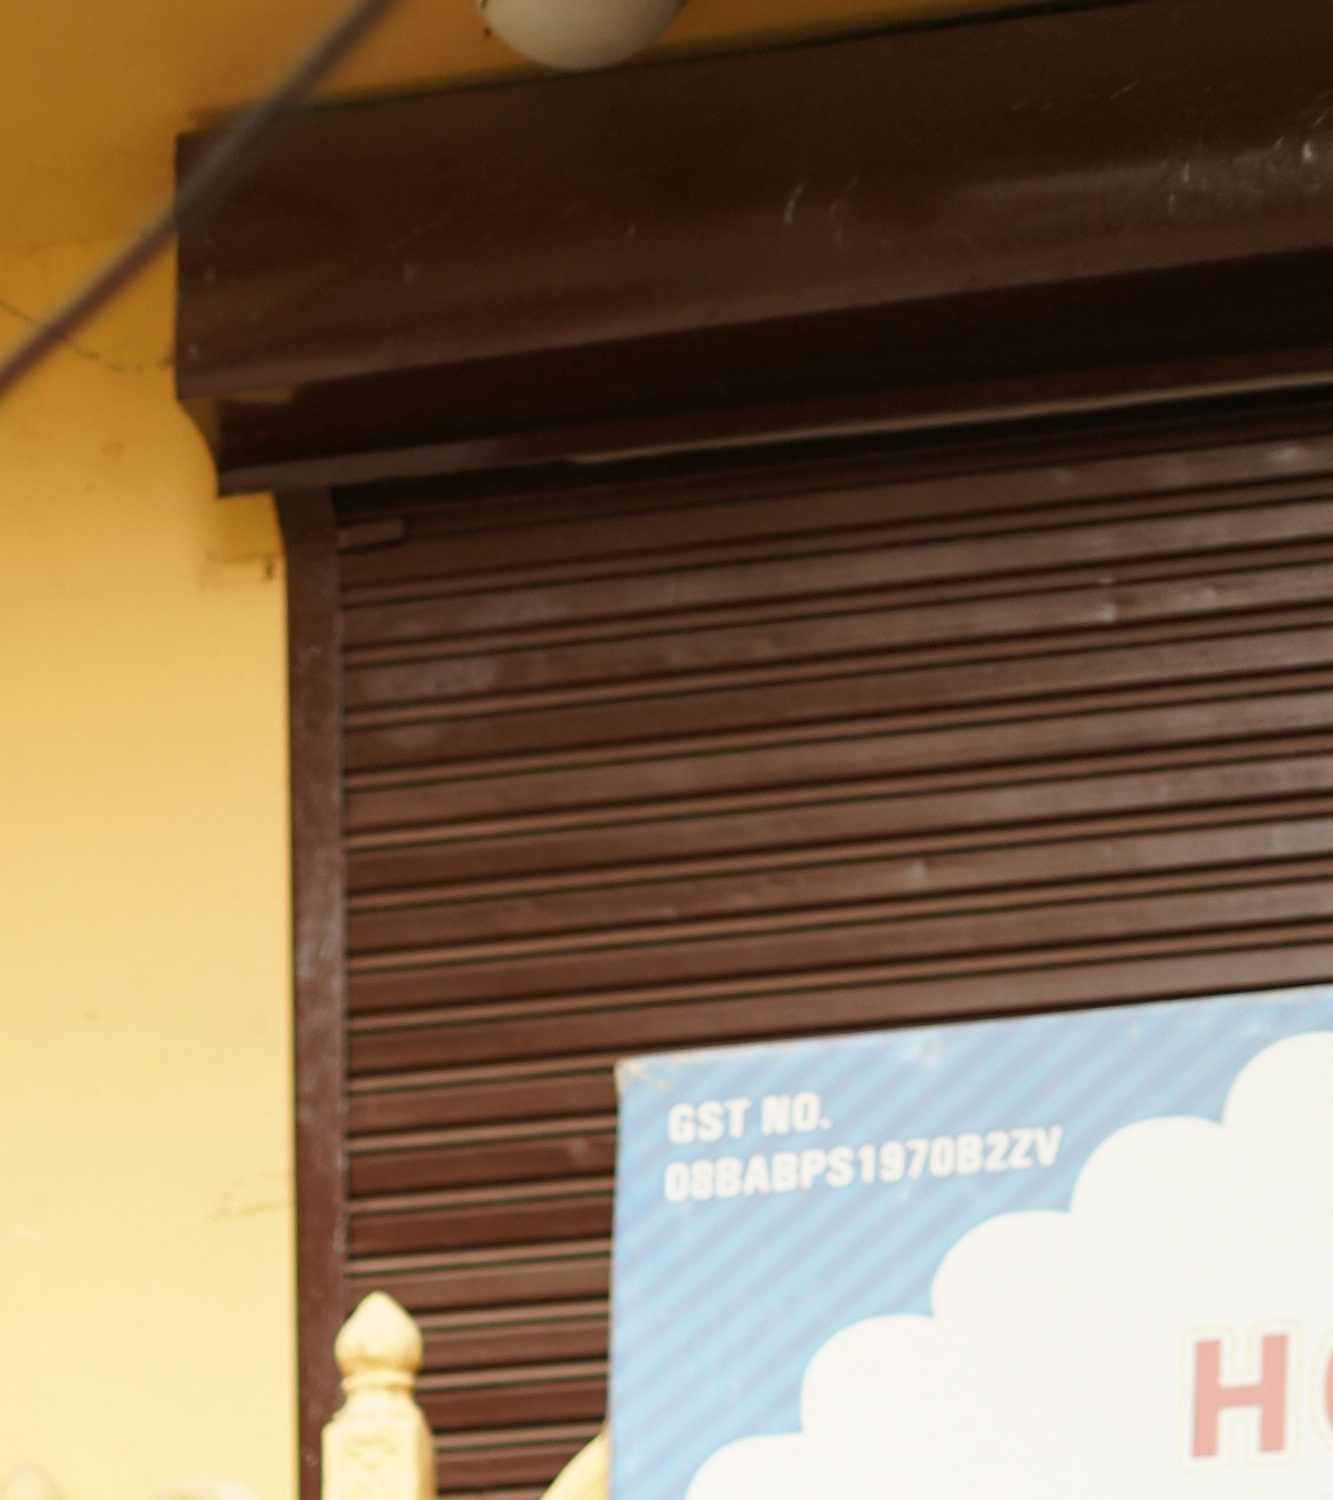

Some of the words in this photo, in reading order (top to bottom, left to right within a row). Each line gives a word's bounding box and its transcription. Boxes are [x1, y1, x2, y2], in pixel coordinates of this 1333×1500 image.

[666, 1097, 752, 1145] GST
[760, 1090, 833, 1137] NO.
[1190, 1331, 1333, 1460] H
